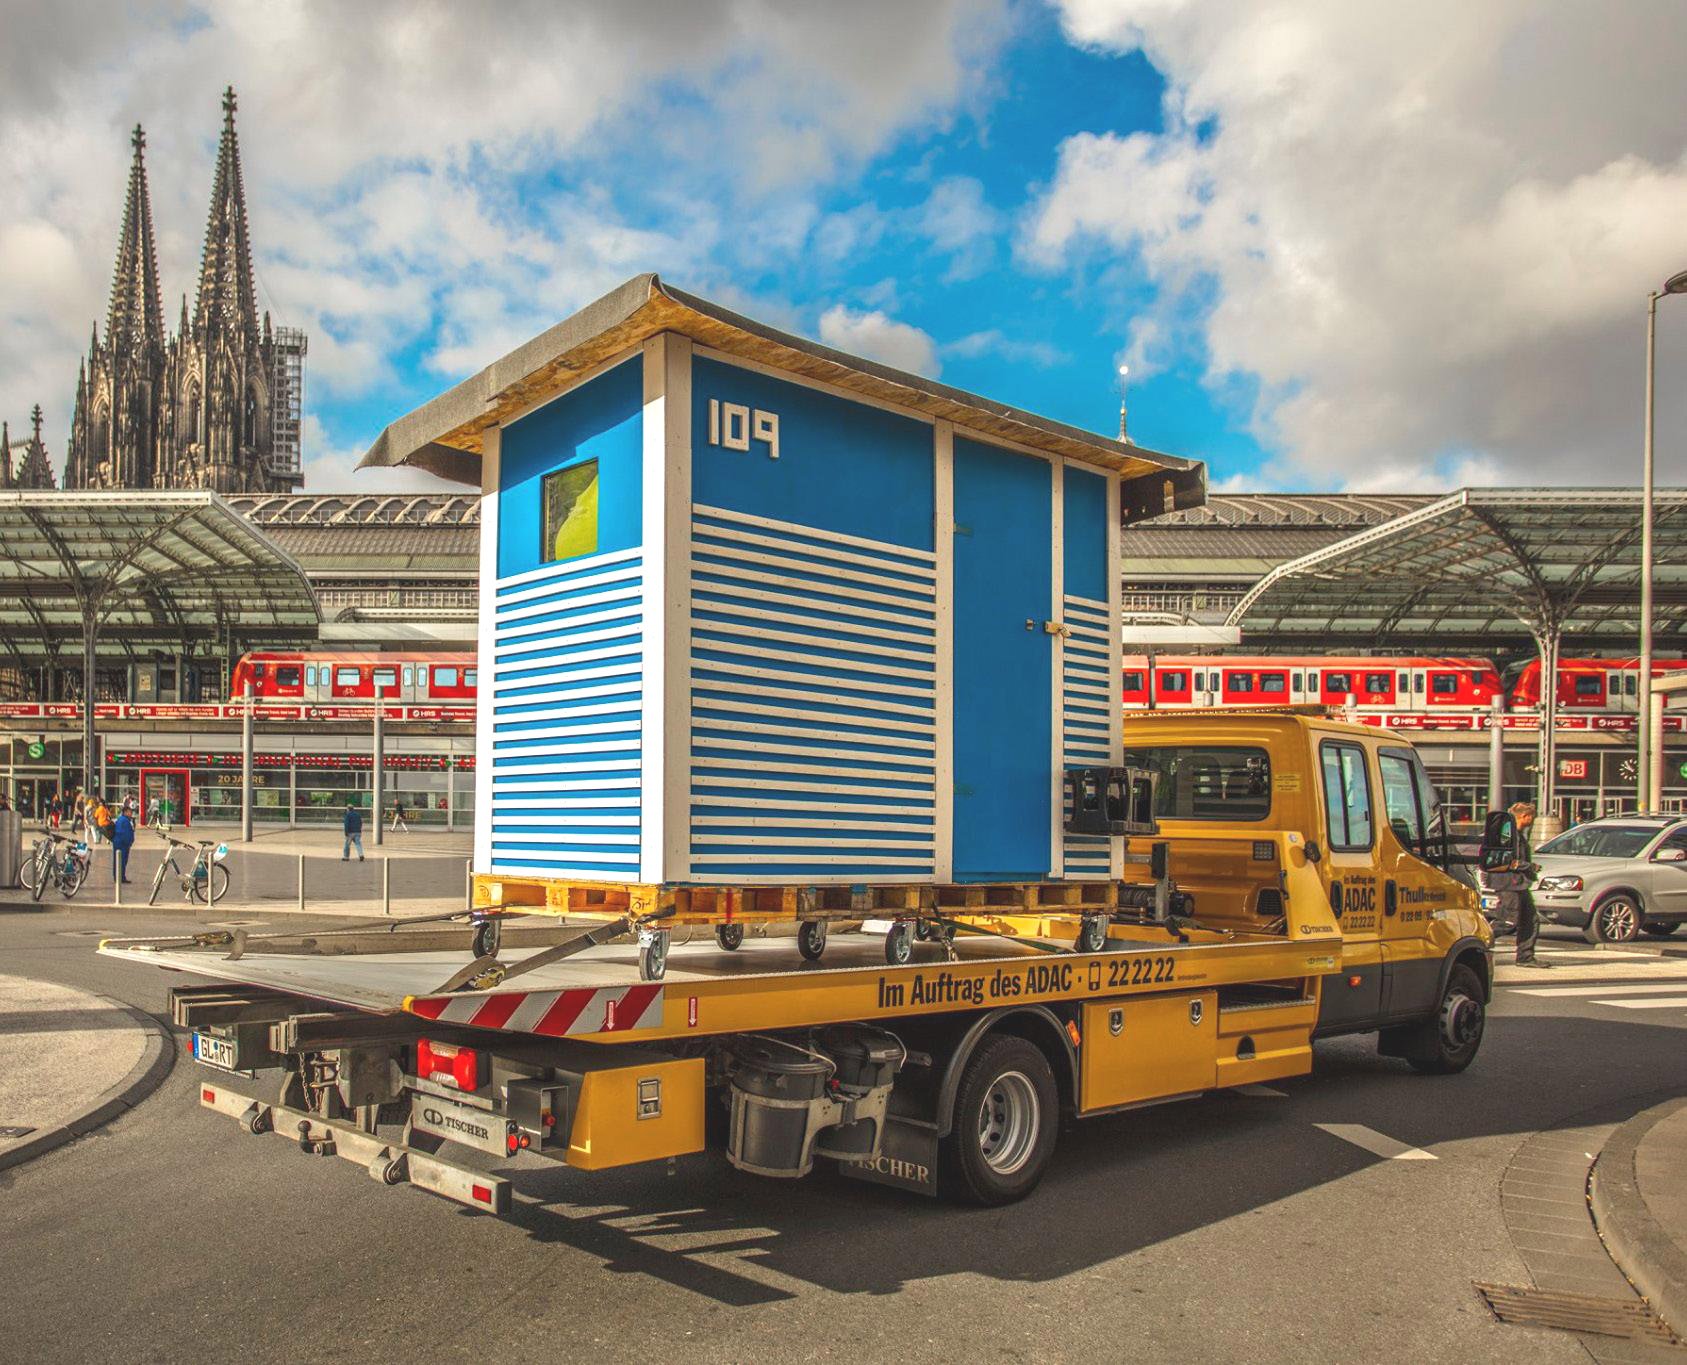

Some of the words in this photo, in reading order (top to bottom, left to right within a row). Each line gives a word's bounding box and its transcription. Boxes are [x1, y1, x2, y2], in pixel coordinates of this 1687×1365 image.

[708, 398, 780, 459] 109
[29, 743, 44, 758] S
[231, 775, 265, 784] JARE
[1344, 887, 1376, 912] ADAC
[878, 976, 904, 1008] Im
[910, 972, 985, 1005] Auftrag
[990, 969, 1021, 998] des
[1025, 963, 1073, 994] ADAC
[201, 1038, 214, 1060] GL
[219, 1043, 233, 1065] RT
[444, 1116, 489, 1140] TISCHER
